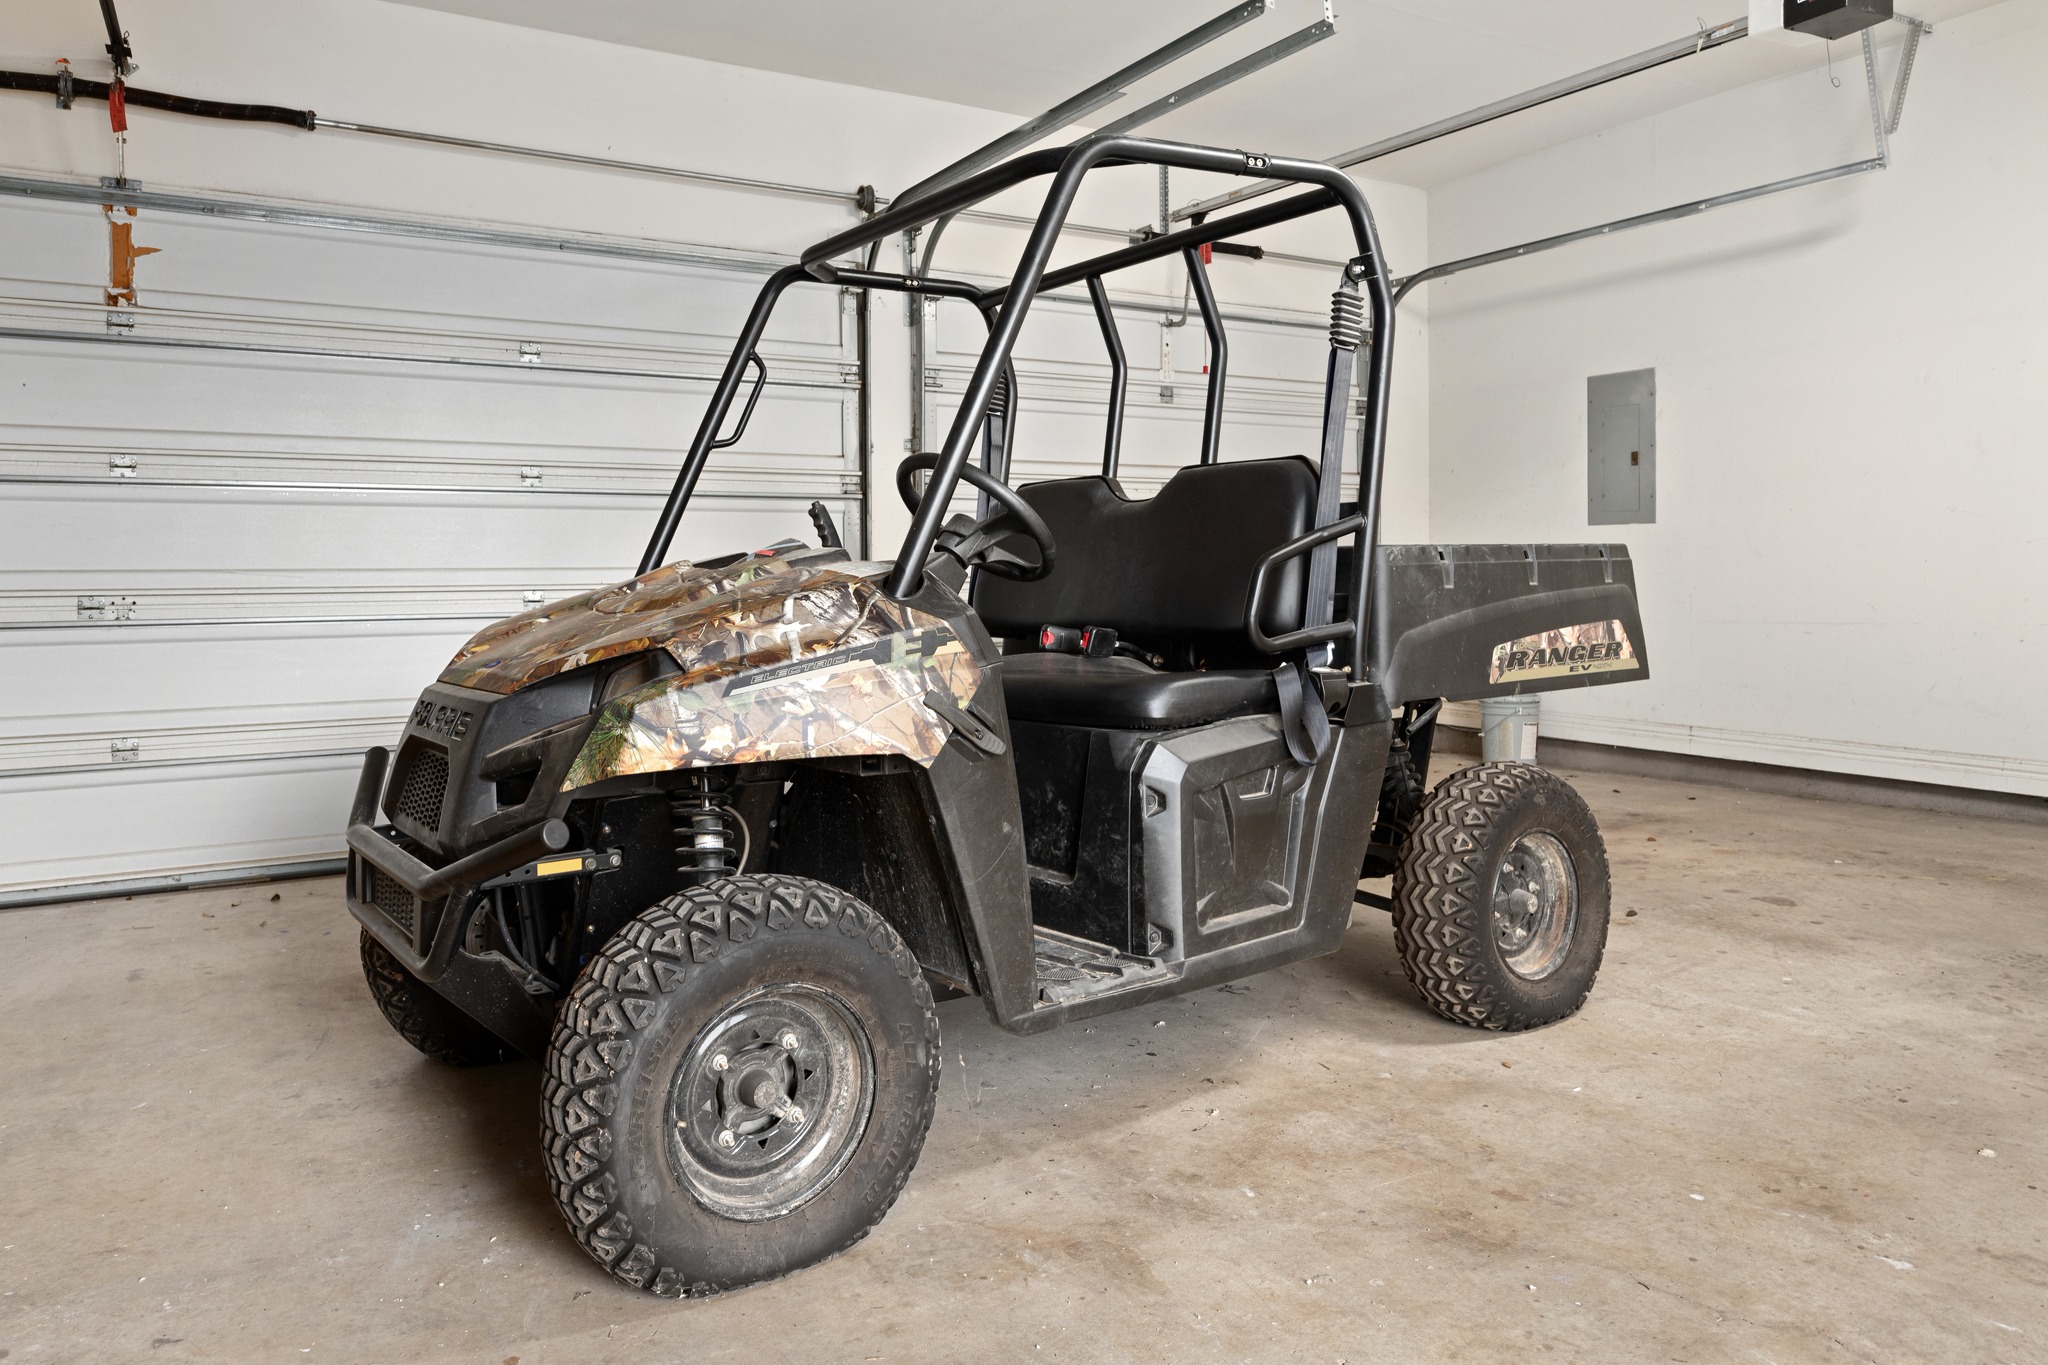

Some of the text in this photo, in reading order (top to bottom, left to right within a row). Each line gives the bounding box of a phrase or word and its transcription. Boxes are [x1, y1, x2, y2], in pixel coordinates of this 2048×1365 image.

[751, 654, 846, 685] ELECTRIC
[1506, 640, 1623, 670] RANGER
[1569, 663, 1593, 673] EV
[410, 700, 474, 741] POLARIS
[897, 1022, 918, 1078] ALL
[629, 1010, 684, 1177] CARLISLE
[878, 1090, 918, 1177] TRAIL
